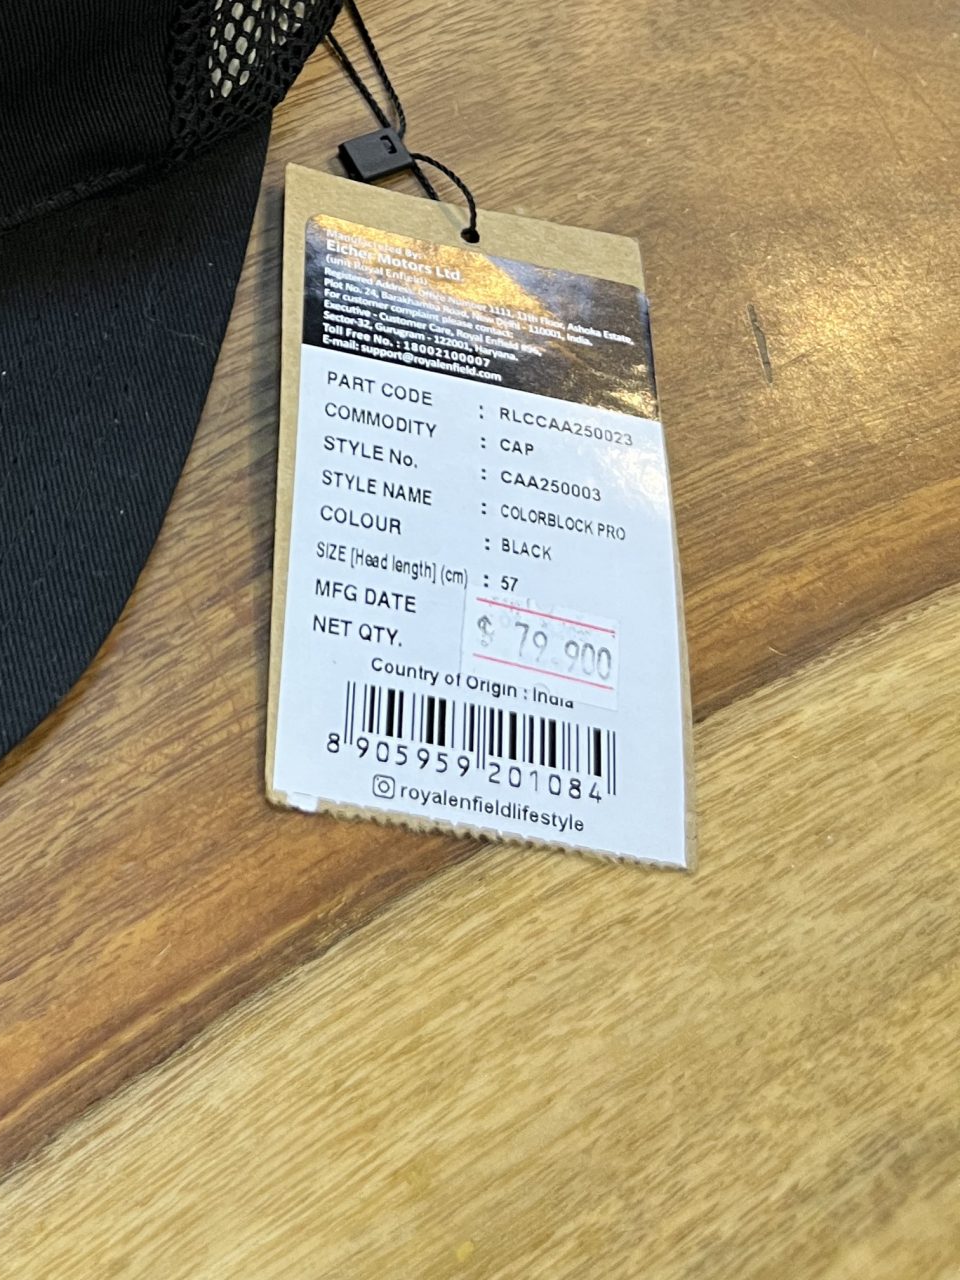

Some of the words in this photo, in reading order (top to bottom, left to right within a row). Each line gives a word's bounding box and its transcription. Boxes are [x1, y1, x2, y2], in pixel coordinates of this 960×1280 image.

[326, 239, 376, 260] Eicher
[377, 253, 433, 275] Motors
[323, 288, 341, 300] For
[341, 293, 389, 311] customer
[323, 298, 372, 318] Executive
[379, 311, 428, 331] Customer
[322, 322, 344, 336] Toll
[345, 327, 372, 342] Free
[373, 333, 394, 348] No.
[403, 340, 491, 368] 18002100007
[374, 322, 426, 342] Gurugram
[567, 322, 602, 338] Ashoka
[322, 333, 360, 351] E-mail:
[360, 343, 503, 382] support@royalenfield.com
[324, 401, 437, 438] COMMODITY
[499, 438, 535, 456] CAP
[327, 370, 376, 395] PART
[381, 382, 433, 407] CODE
[499, 406, 634, 447] RLCCAA250023
[323, 435, 384, 462] STYLE
[389, 448, 418, 469] No.
[500, 470, 602, 502] CAA250003
[321, 469, 377, 495] STYLE
[382, 481, 433, 506] NAME
[500, 503, 594, 536] COLORBLOCK
[597, 522, 626, 541] PRO
[320, 505, 402, 535] COLOUR
[501, 537, 552, 561] BLACK
[316, 540, 347, 562] SIZE
[350, 547, 389, 570] [Head
[392, 554, 437, 584] length]
[440, 564, 468, 591] (cm)
[500, 575, 519, 592] 57
[315, 578, 358, 602] MFG
[365, 587, 417, 613] DATE
[312, 613, 353, 637] NET
[358, 623, 403, 648] QTY.
[371, 657, 440, 686] Country
[445, 672, 462, 688] of
[466, 675, 518, 699] Origin
[400, 782, 585, 833] royalenfieldlifestyle
